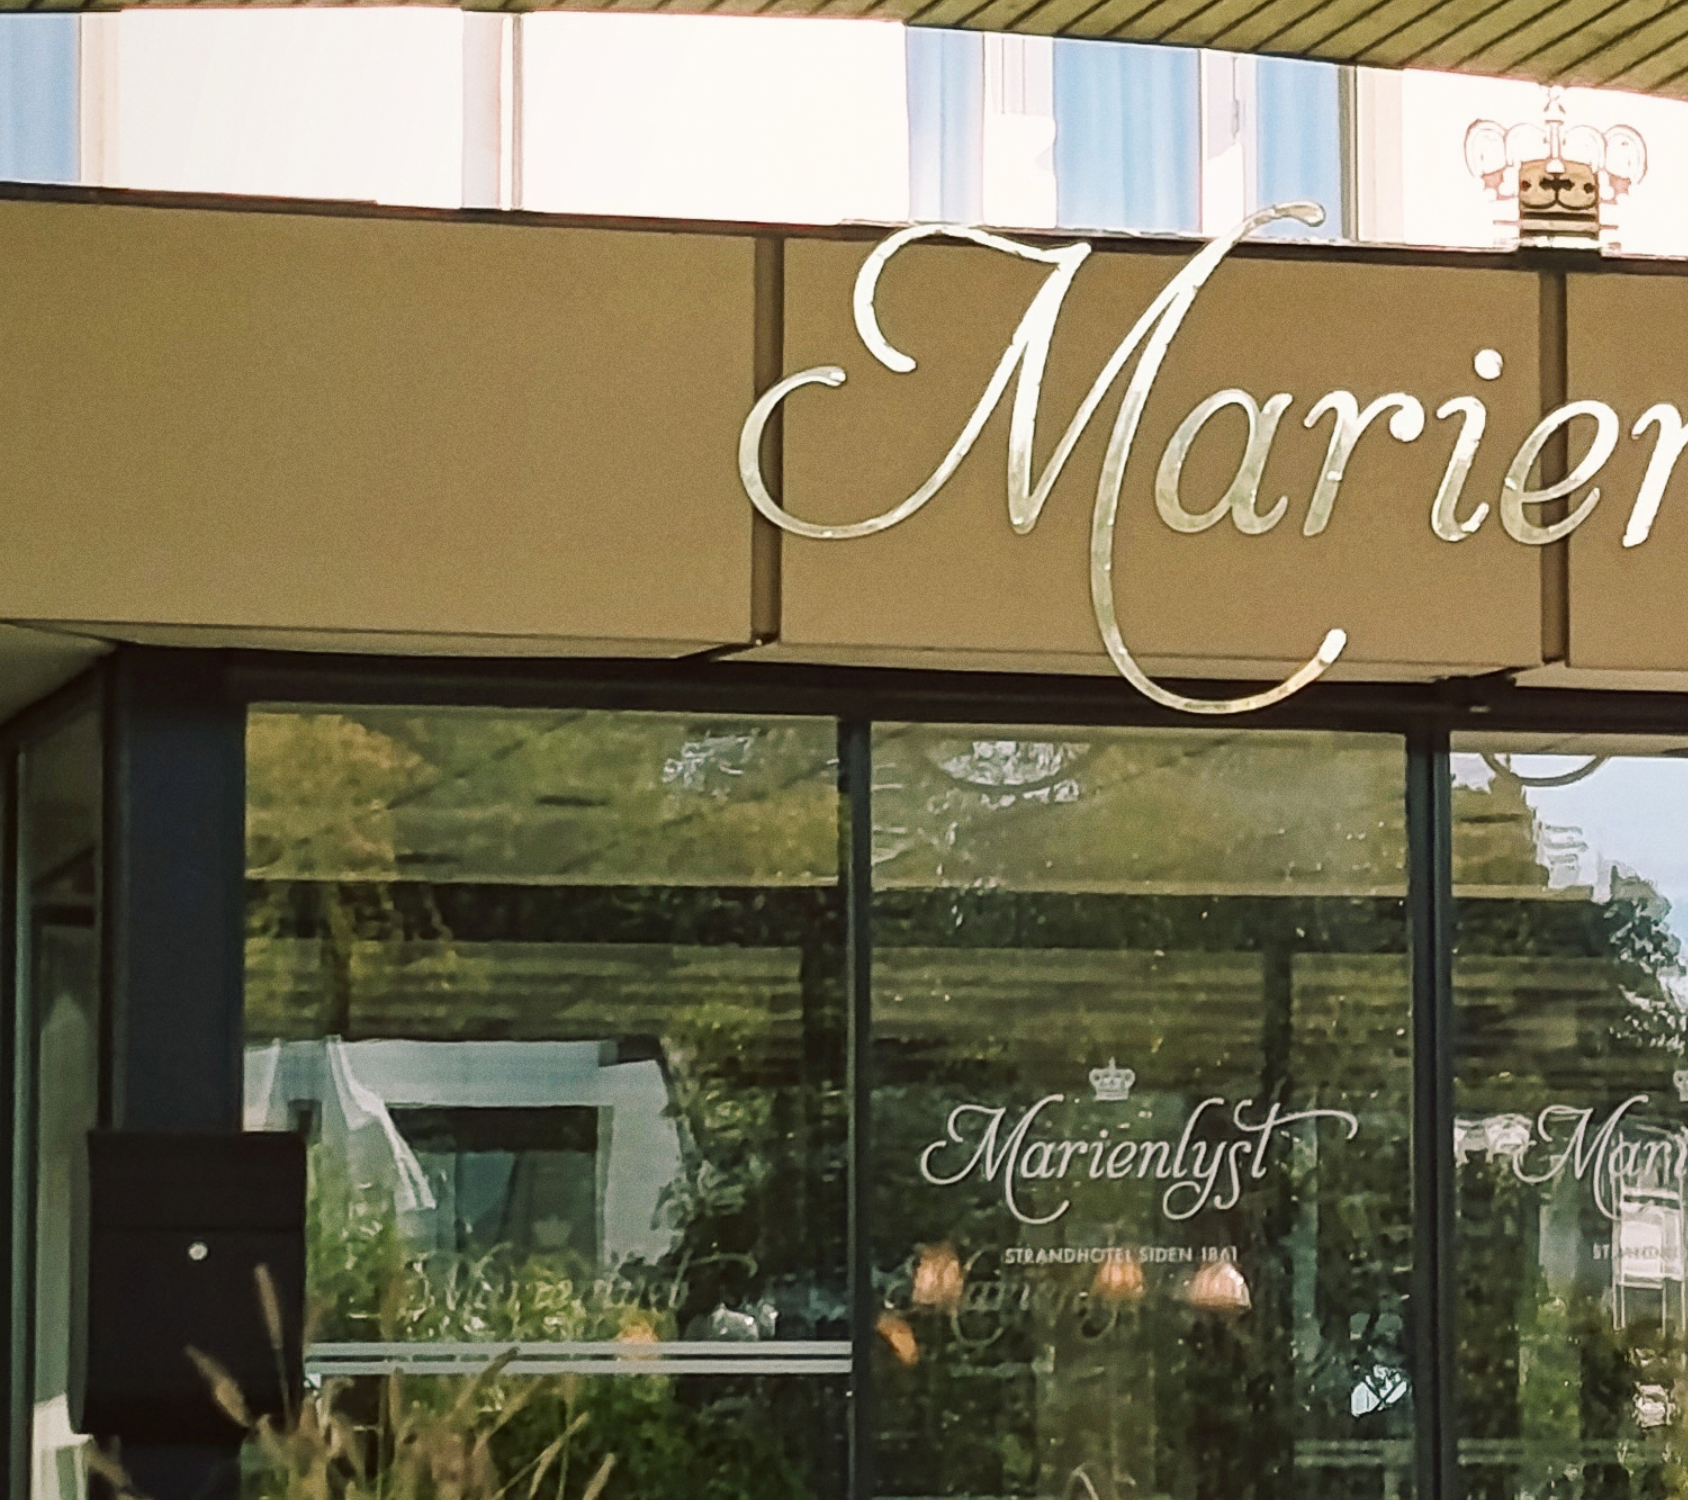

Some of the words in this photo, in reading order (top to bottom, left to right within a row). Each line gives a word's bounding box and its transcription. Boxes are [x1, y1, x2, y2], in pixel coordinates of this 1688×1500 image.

[919, 1094, 1360, 1225] Marienlyst
[1004, 1247, 1132, 1265] STRANDHOTEL
[1138, 1246, 1193, 1263] SIDEN
